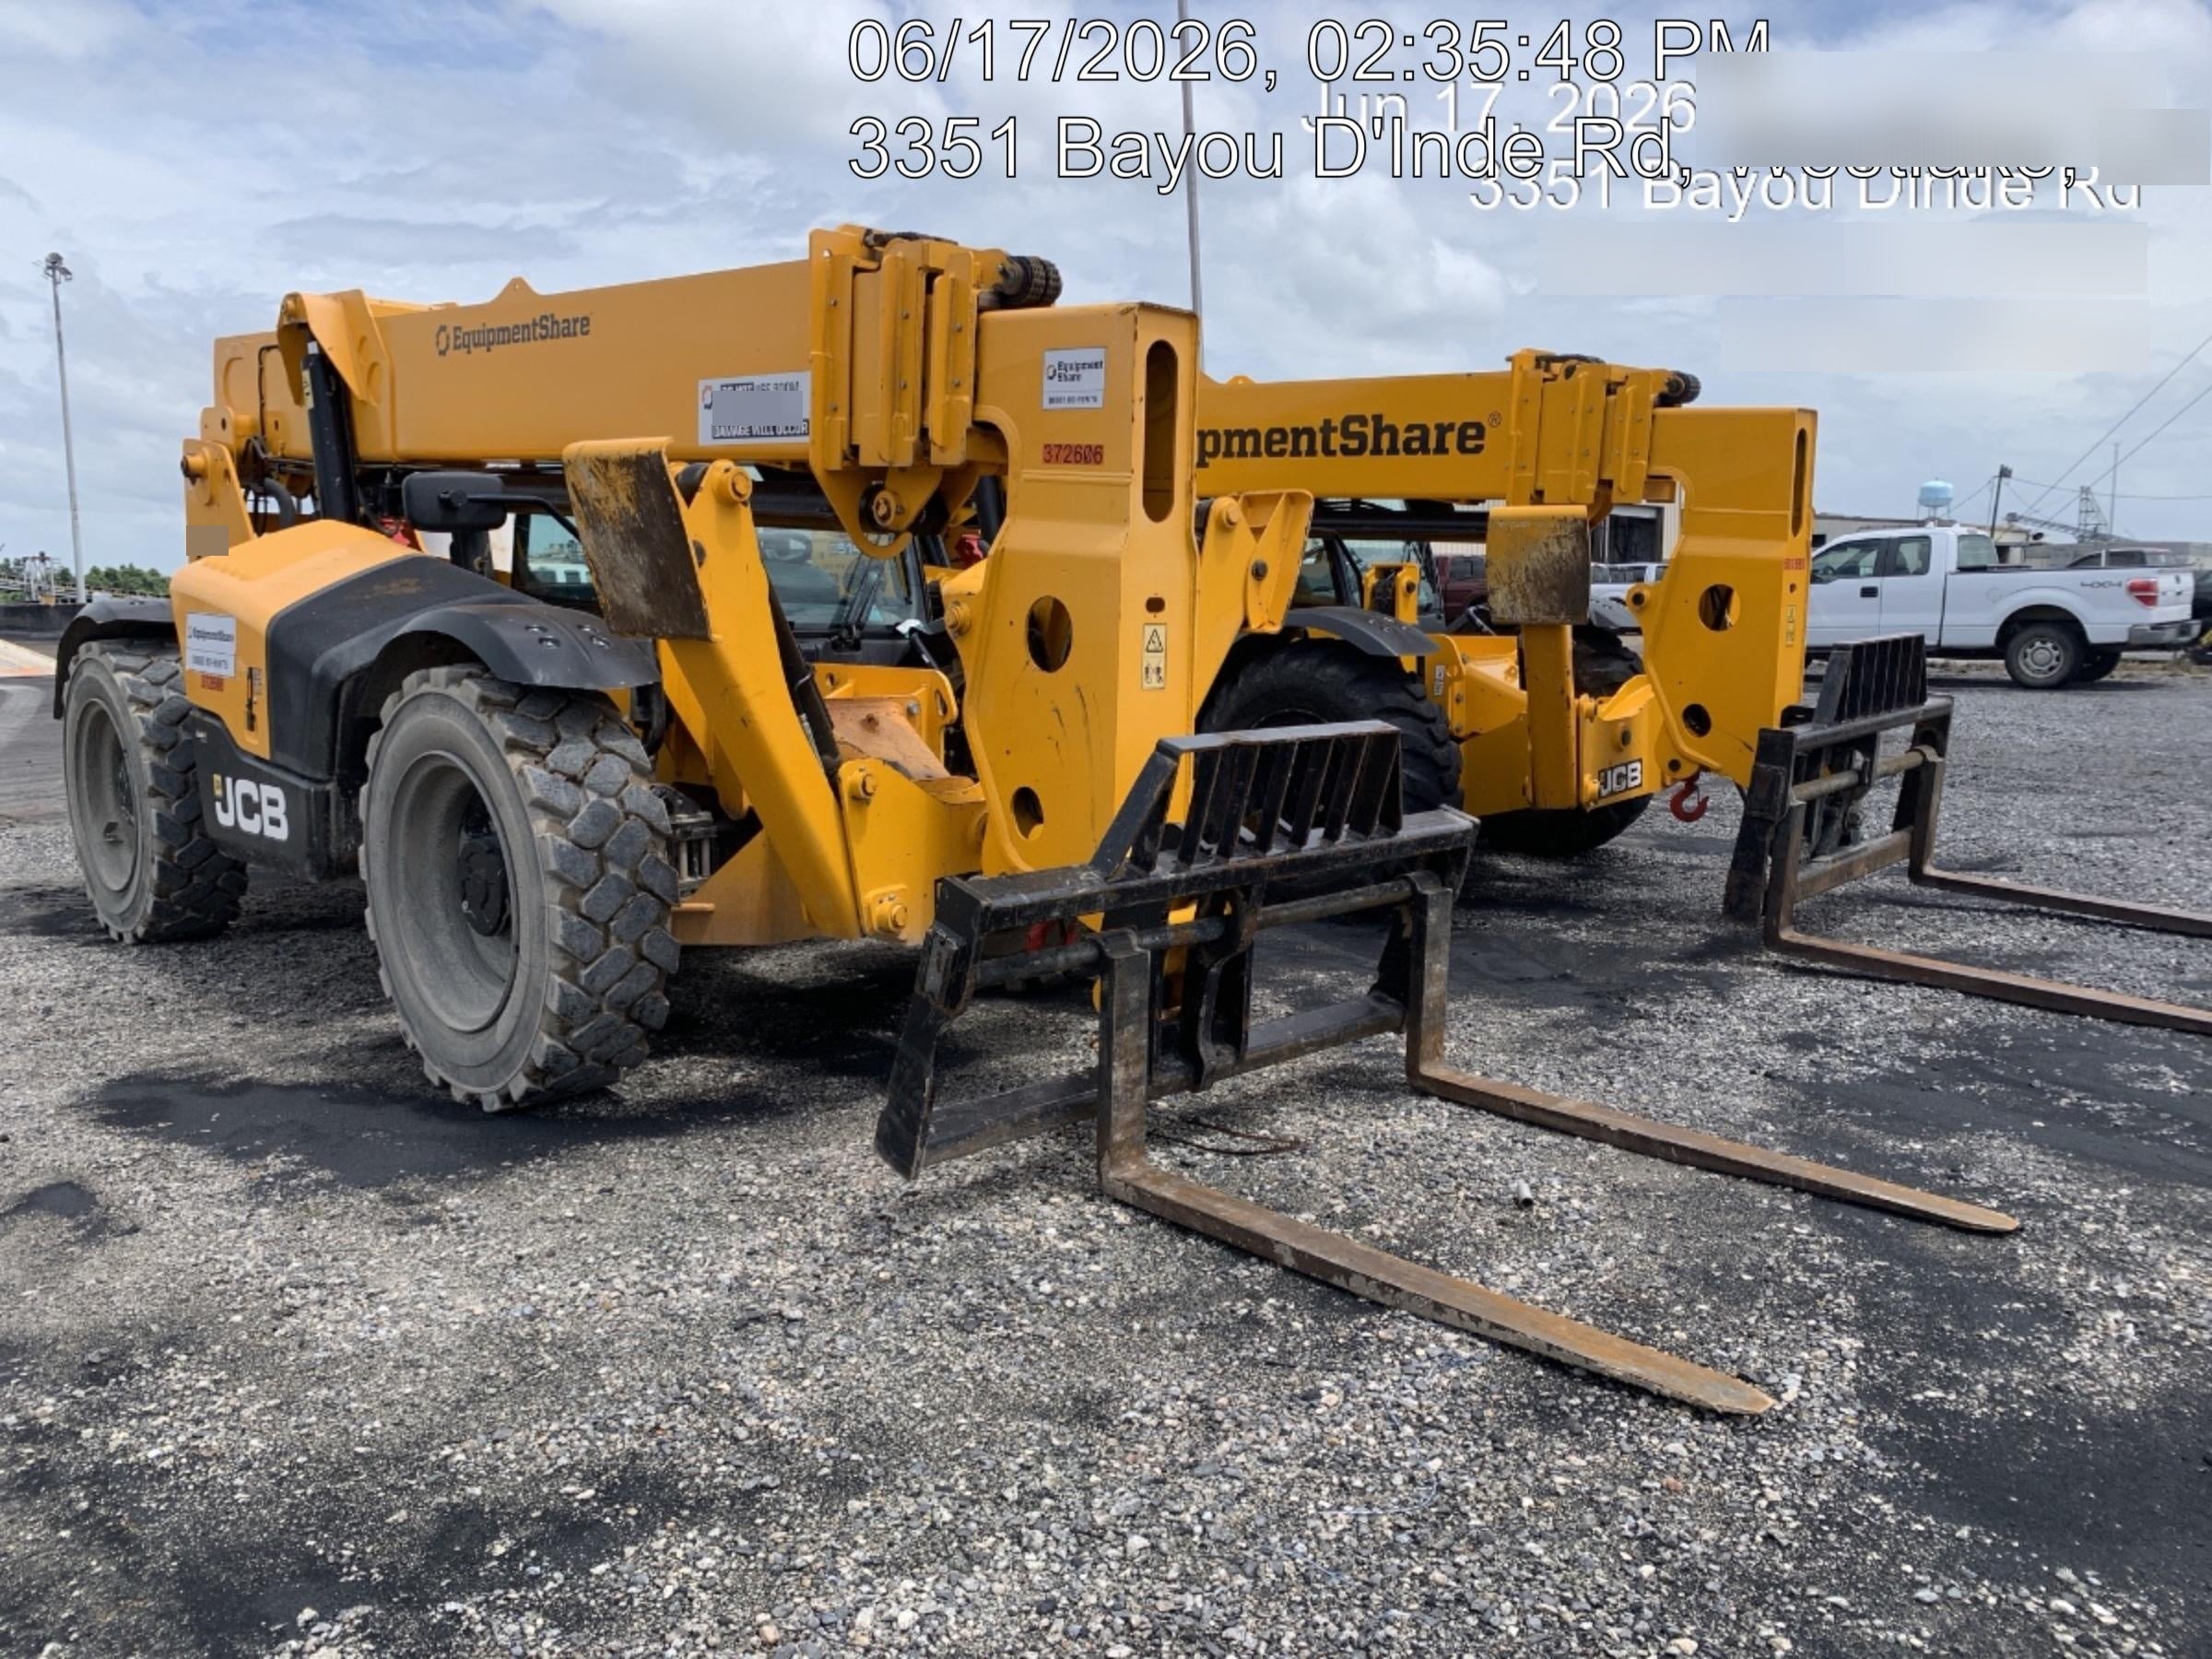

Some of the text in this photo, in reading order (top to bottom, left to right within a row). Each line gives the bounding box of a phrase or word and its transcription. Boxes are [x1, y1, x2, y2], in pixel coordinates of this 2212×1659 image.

[453, 313, 592, 355] EquipmentShare
[1195, 413, 1486, 468] pmentShare
[1599, 760, 1642, 797] JCB
[215, 776, 288, 841] JCB
